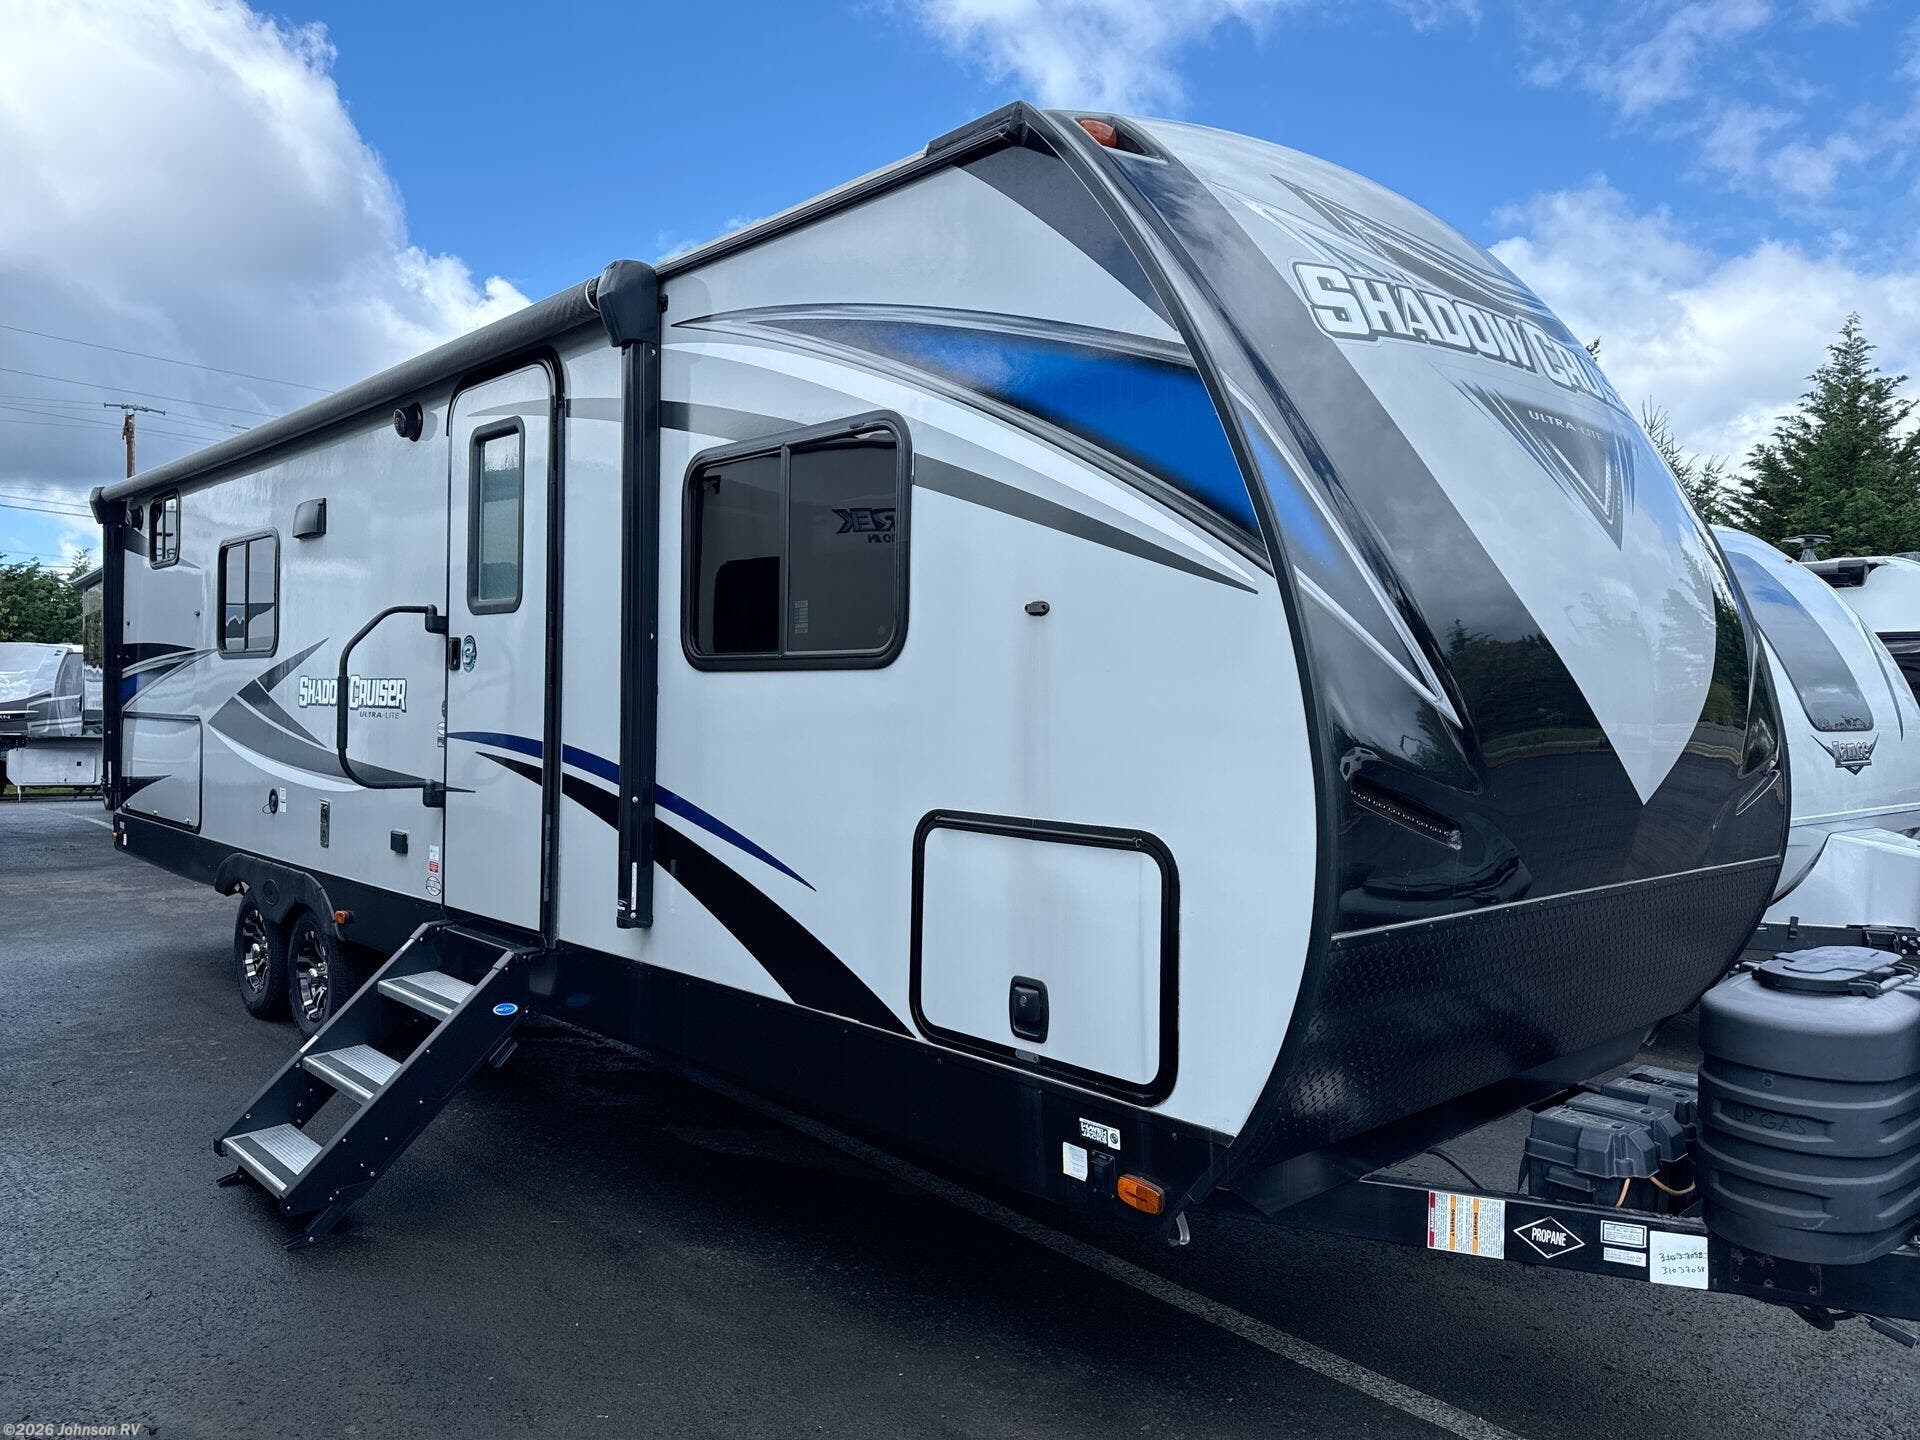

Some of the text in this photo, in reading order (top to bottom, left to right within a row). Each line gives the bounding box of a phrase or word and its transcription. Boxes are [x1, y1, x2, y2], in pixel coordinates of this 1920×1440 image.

[299, 674, 407, 712] SHADO CRUISER
[359, 711, 400, 719] ULTRA-LITE
[1760, 1112, 1806, 1136] GAS
[1531, 1227, 1567, 1246] PROPANE
